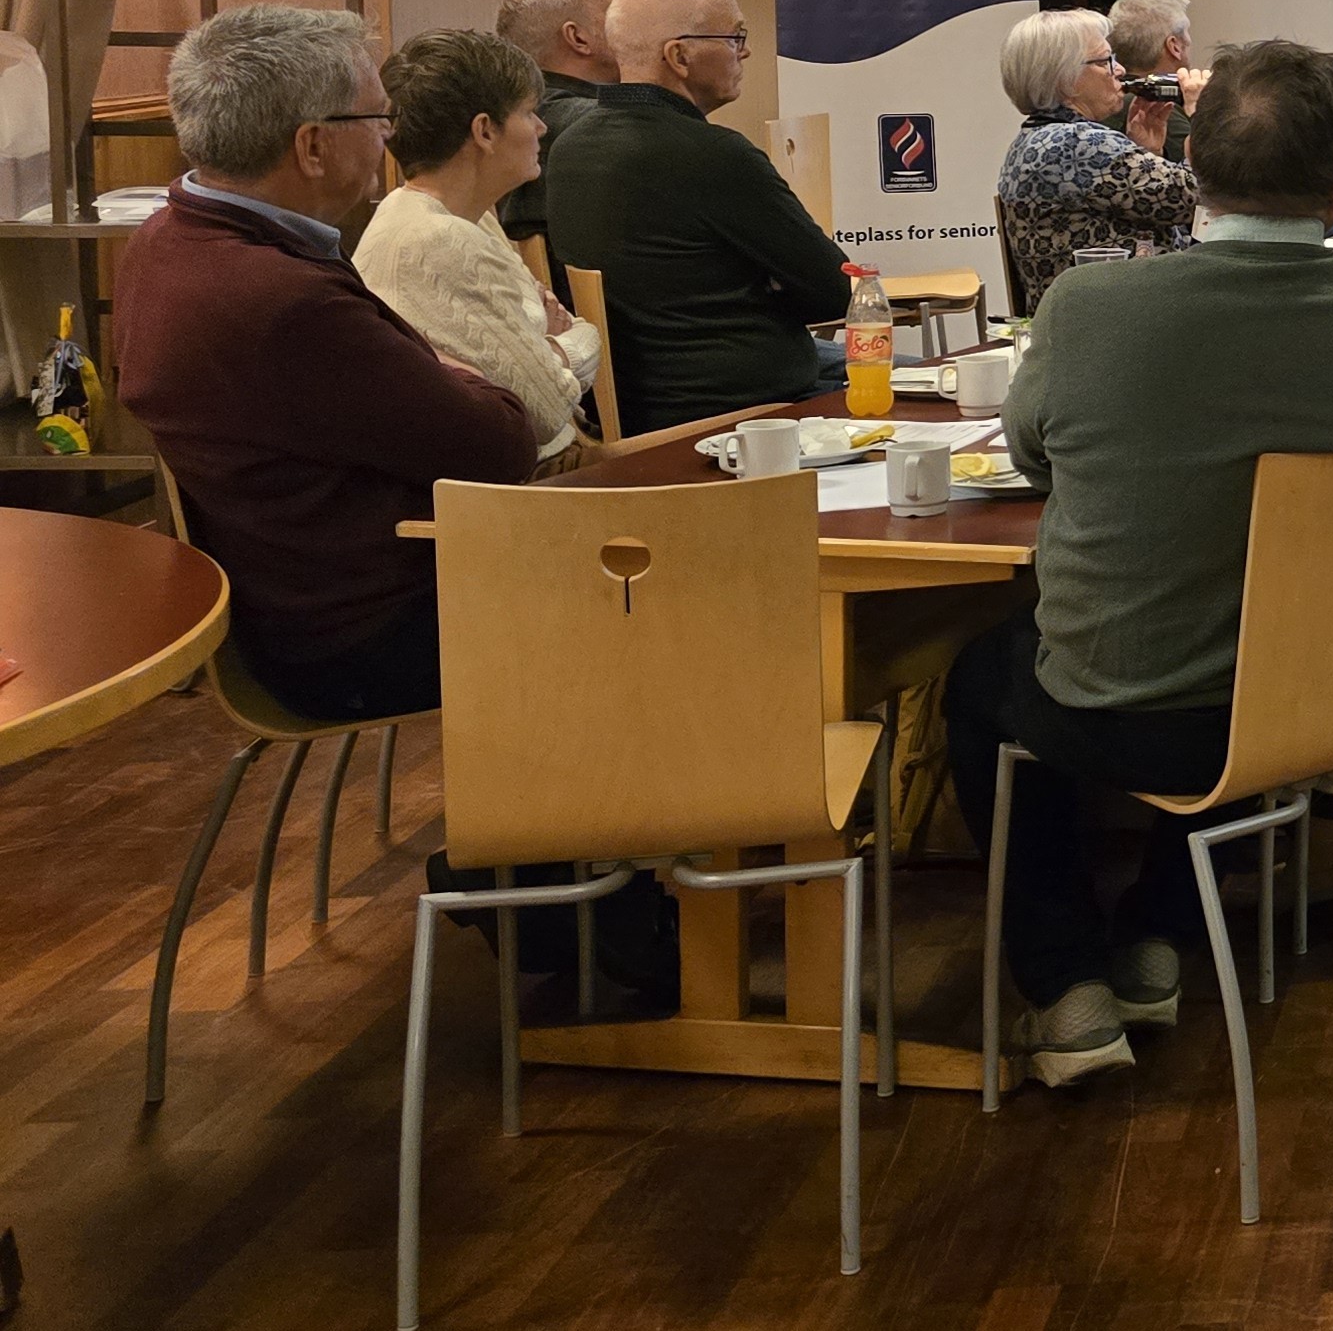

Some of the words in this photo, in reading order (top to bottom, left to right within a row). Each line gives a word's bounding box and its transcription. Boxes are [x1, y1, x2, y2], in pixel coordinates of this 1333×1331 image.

[832, 227, 903, 246] teplass
[908, 225, 935, 240] for
[940, 223, 997, 239] senior
[851, 335, 885, 355] Solo
